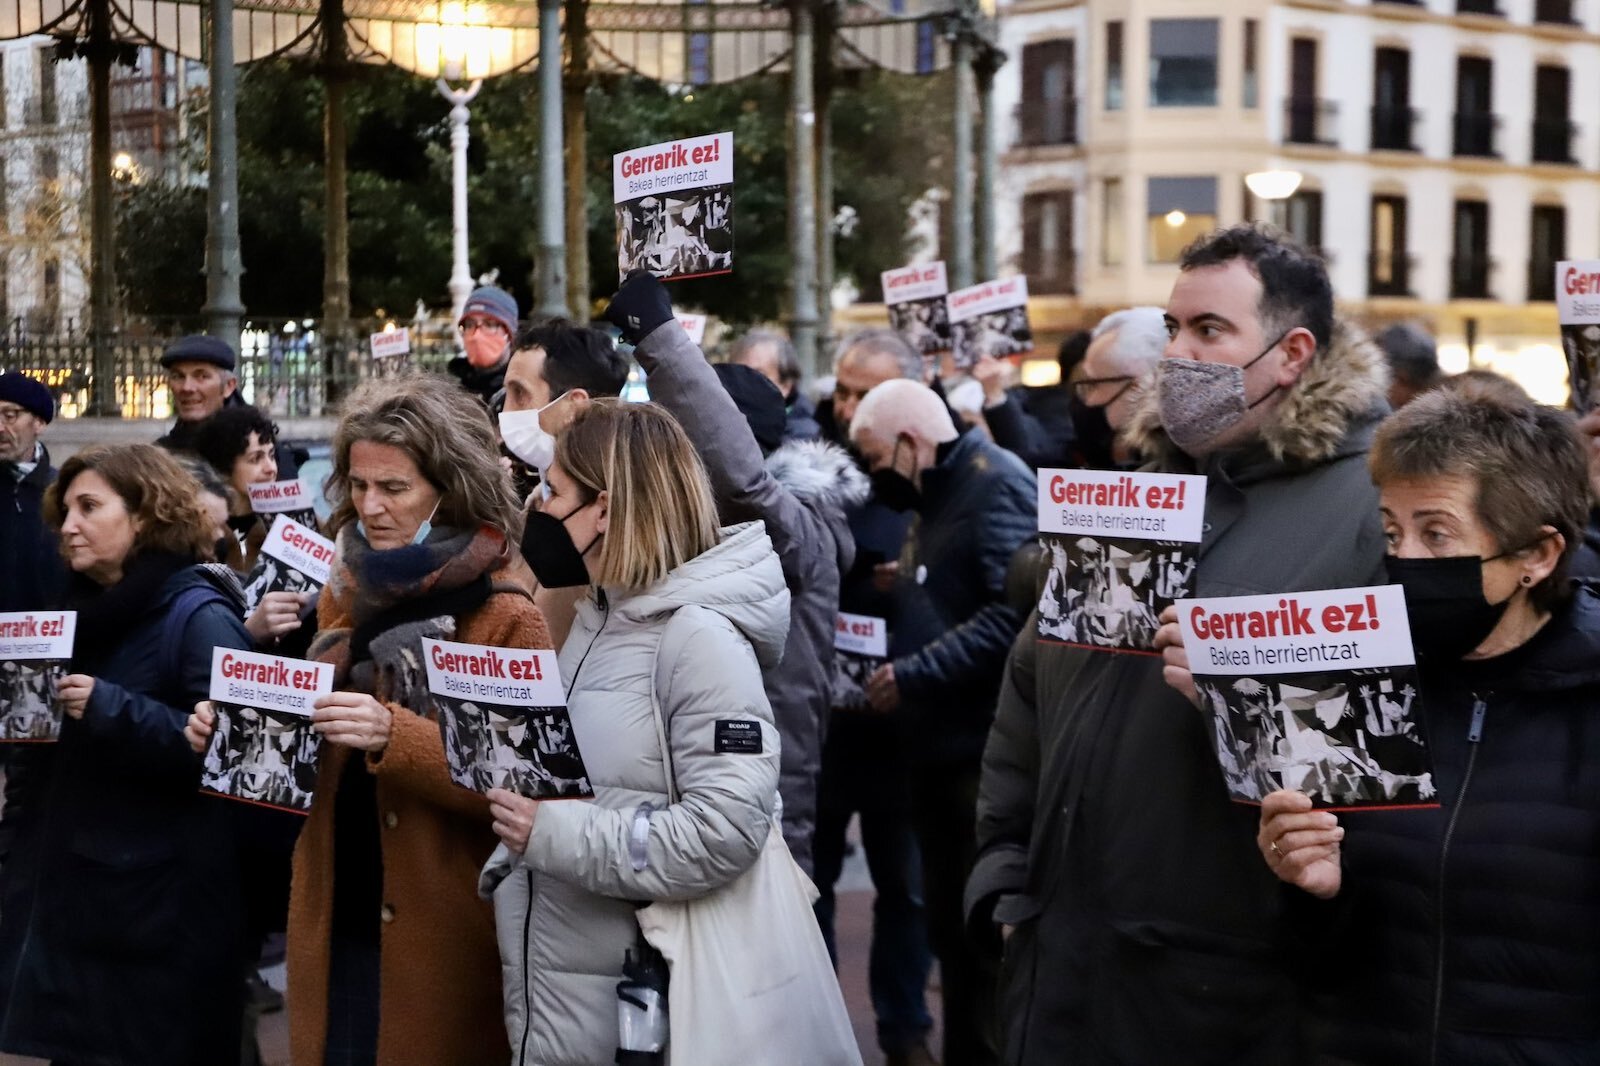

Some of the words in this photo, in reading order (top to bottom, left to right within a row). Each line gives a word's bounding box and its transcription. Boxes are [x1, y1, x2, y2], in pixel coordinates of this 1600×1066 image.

[621, 144, 688, 178] Gerrarik
[691, 139, 719, 164] ez!
[629, 178, 652, 193] Bakea
[655, 169, 708, 187] herrientzat
[283, 482, 301, 496] ez!
[1050, 475, 1141, 507] Gerrarik
[1146, 480, 1186, 510] ez!
[1062, 509, 1093, 527] Bakea
[1096, 511, 1166, 532] herrientzat
[41, 615, 64, 636] ez!
[1190, 599, 1315, 640] Gerrarik
[1321, 594, 1380, 633] ez!
[432, 644, 506, 678] Gerrarik
[508, 655, 543, 680] ez!
[1210, 646, 1250, 666] Bakea
[1254, 640, 1360, 665] herrientzat
[221, 653, 289, 687] Gerrarik
[293, 667, 319, 691] ez!
[228, 683, 254, 700] Bakea
[256, 687, 306, 708] herrientzat
[444, 676, 472, 693] Bakea
[473, 680, 532, 700] herrientzat
